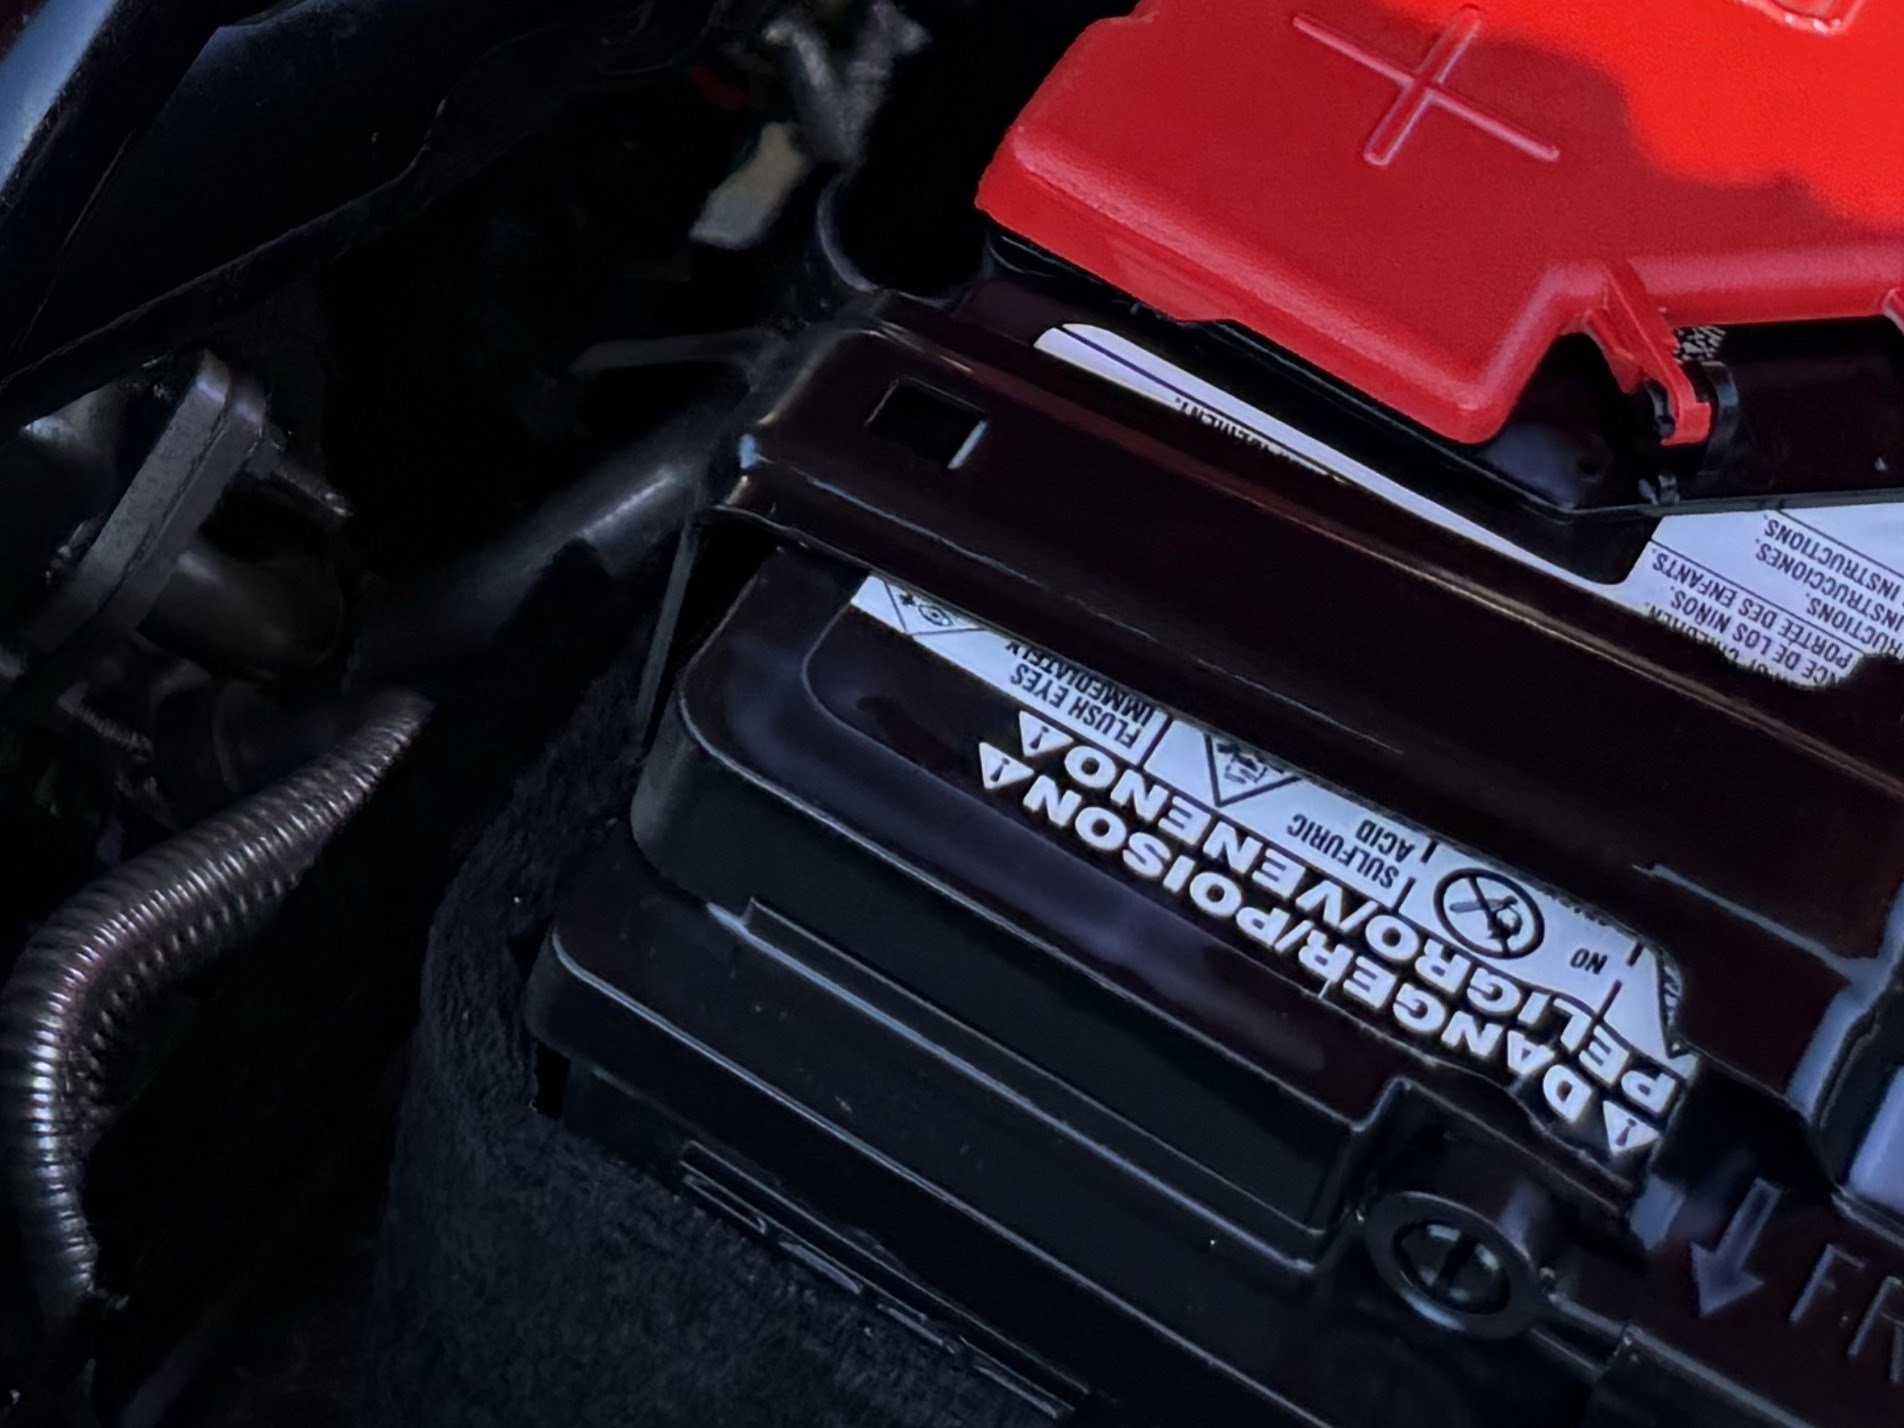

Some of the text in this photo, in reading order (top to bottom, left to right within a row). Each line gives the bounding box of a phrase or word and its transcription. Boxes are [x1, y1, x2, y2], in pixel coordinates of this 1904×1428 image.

[1643, 547, 1738, 608] ENFANTS.
[1662, 584, 1731, 632] NIÑOS.
[1737, 596, 1777, 629] DES
[1730, 621, 1773, 655] LOS
[1771, 643, 1801, 670] DE
[1775, 617, 1854, 671] PORTÉE
[1008, 660, 1143, 748] FLUSH EYES
[1284, 809, 1401, 889] SULFURIC
[1353, 815, 1415, 865] ACID
[1023, 777, 1596, 1122] DANGER/POISON
[1064, 744, 1677, 1112] PELIGRO/VENENO
[1568, 943, 1608, 979] NO
